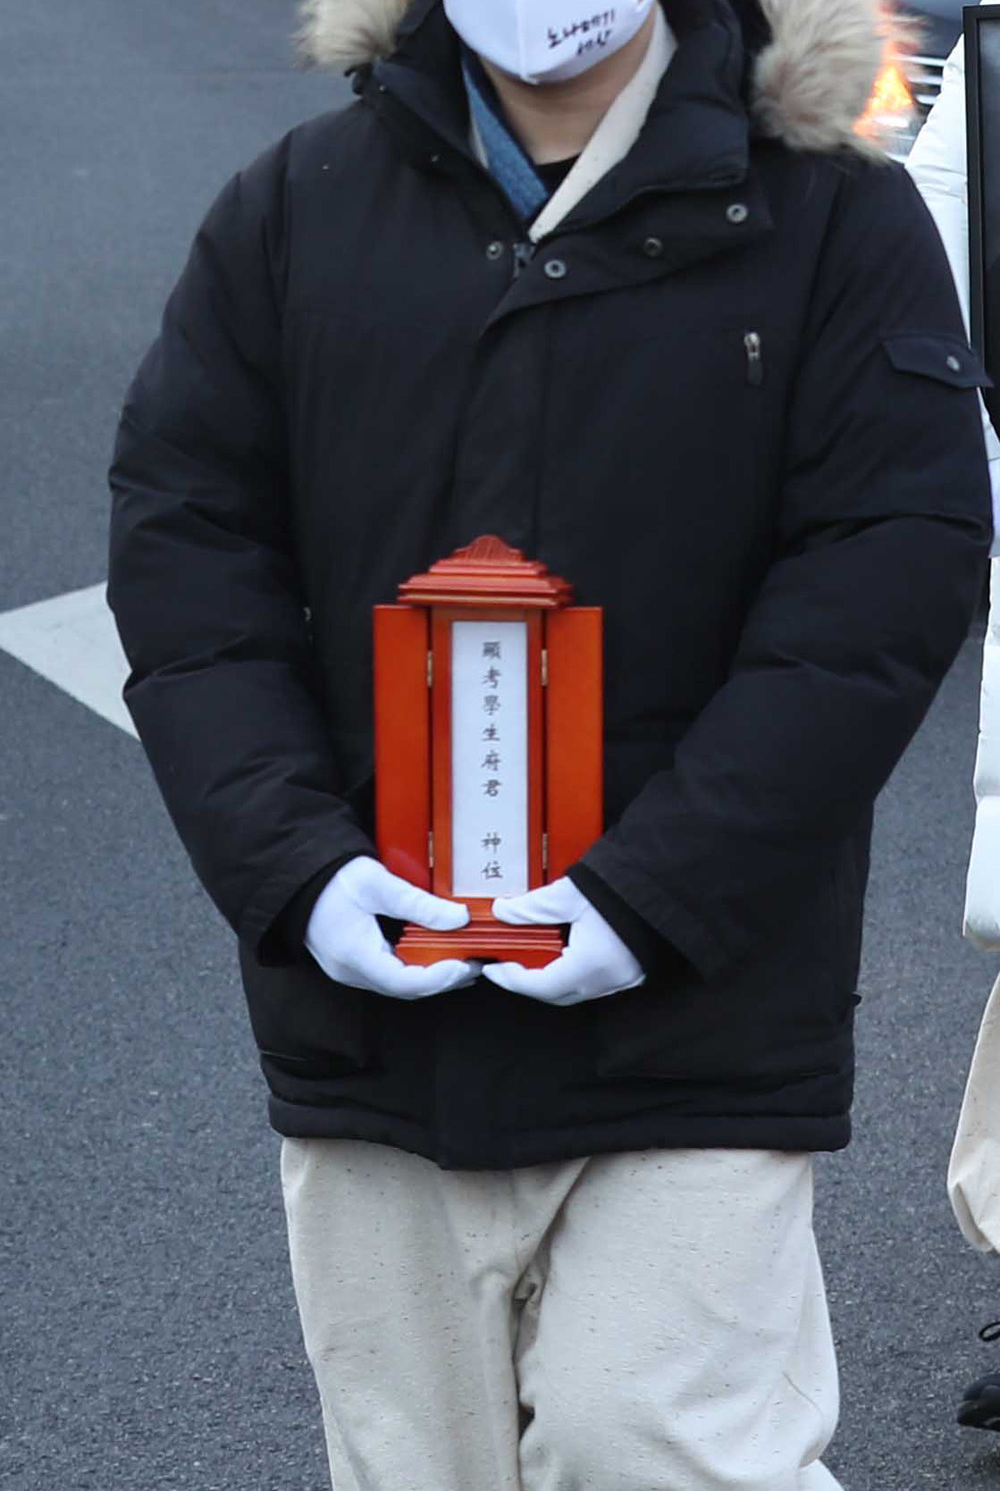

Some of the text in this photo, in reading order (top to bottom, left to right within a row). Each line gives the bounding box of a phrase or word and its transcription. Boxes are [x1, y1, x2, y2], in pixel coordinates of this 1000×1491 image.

[548, 9, 615, 49] 노나메기
[577, 30, 613, 56] 세상
[482, 832, 503, 879] 神位
